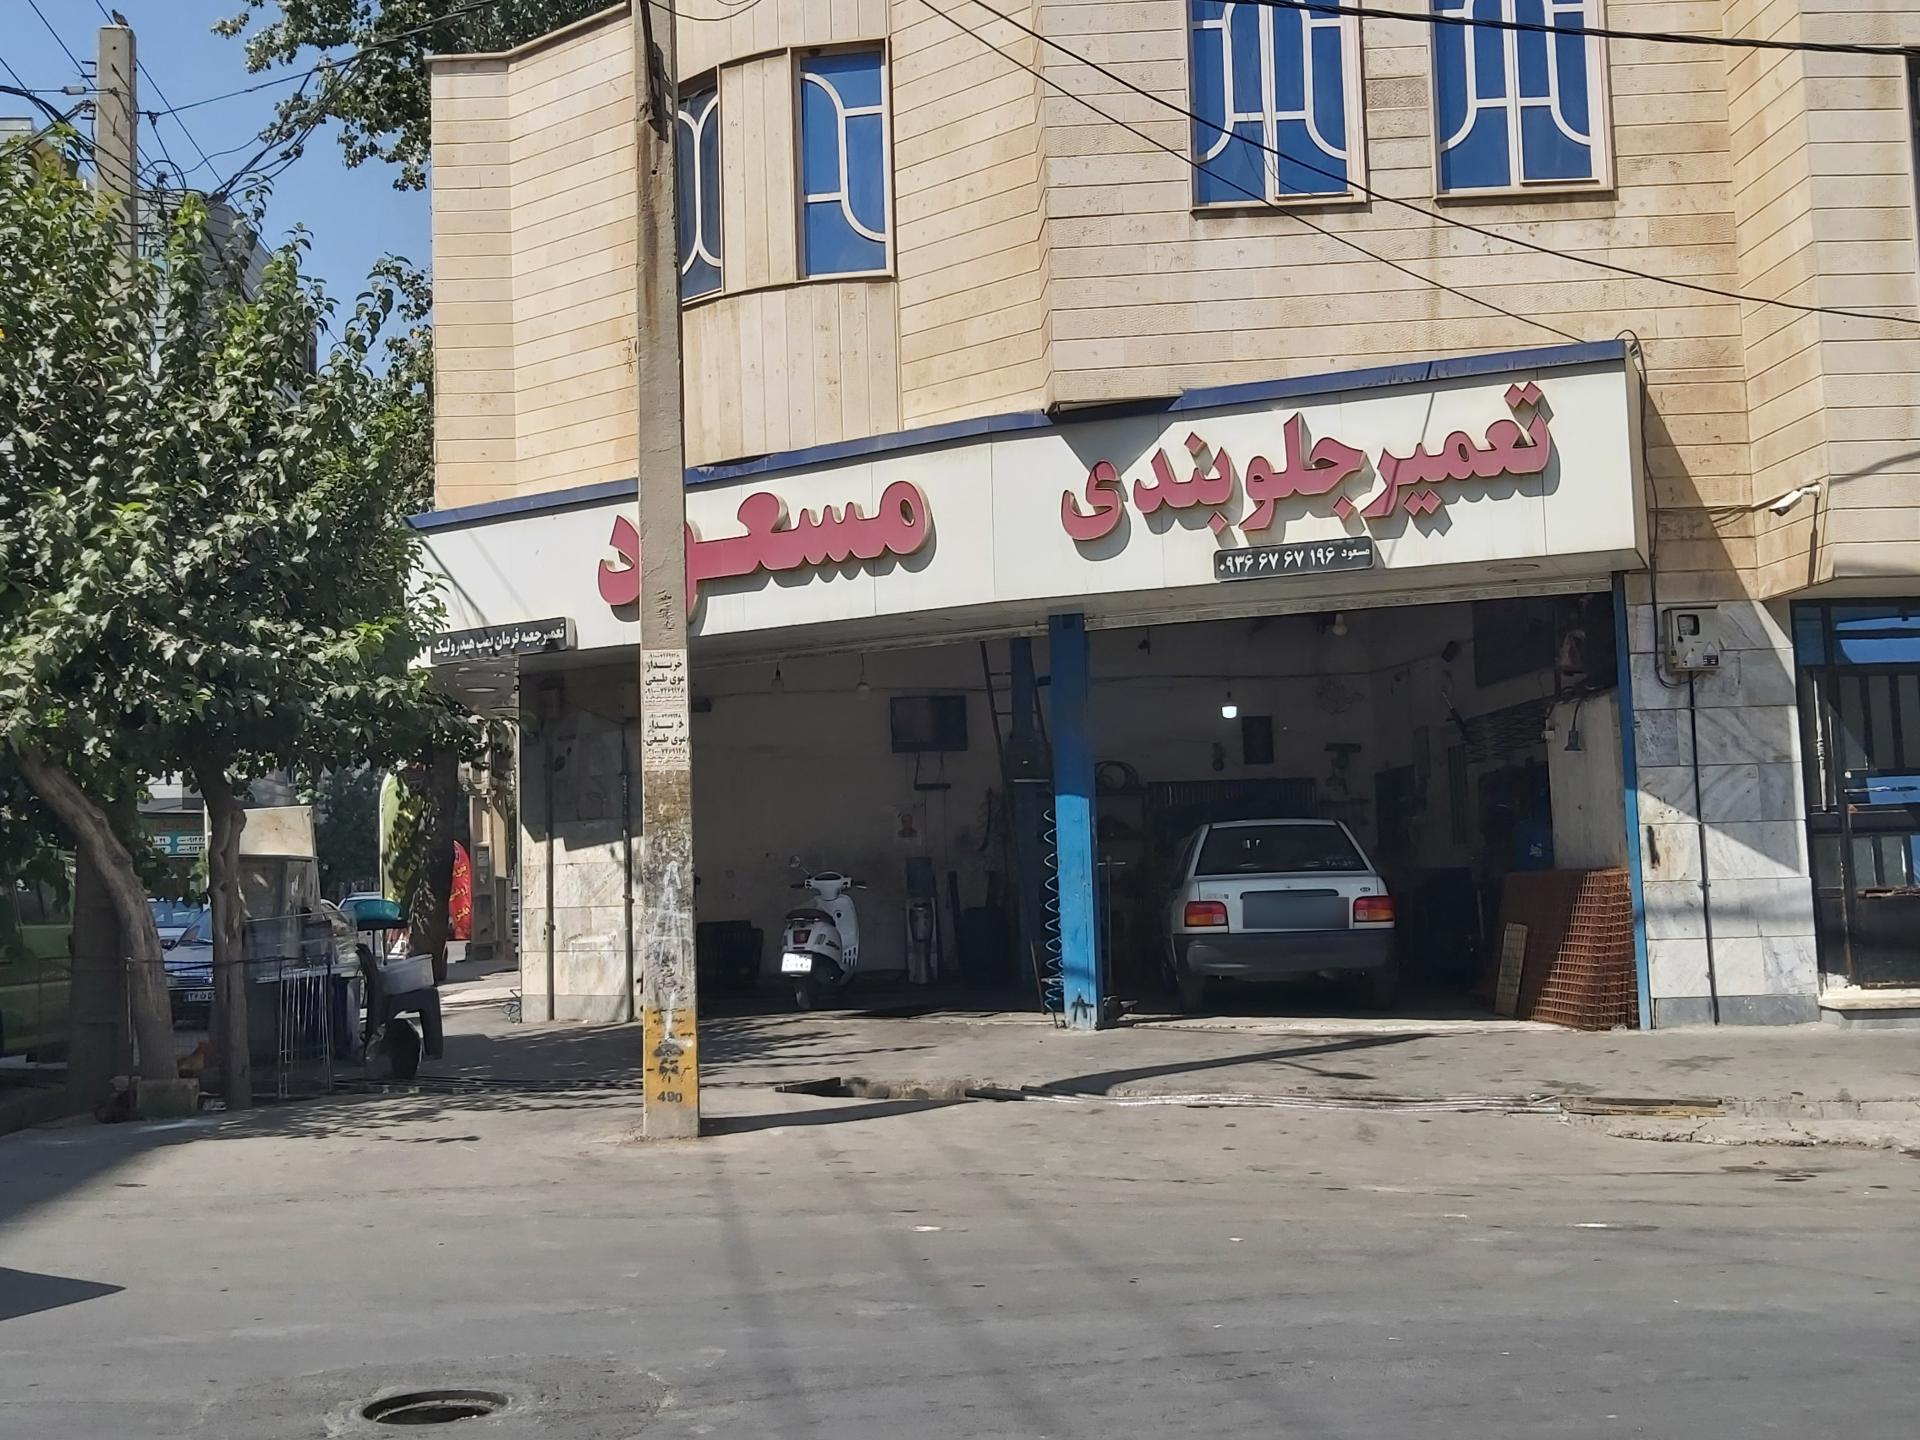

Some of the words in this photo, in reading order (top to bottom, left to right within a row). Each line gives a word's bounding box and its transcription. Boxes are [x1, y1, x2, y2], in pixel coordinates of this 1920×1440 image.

[1360, 381, 1551, 518] تعمیر
[1060, 411, 1364, 541] جلوبندی
[1219, 554, 1254, 574] ۰۹۳۶
[1258, 551, 1279, 571] ۶۷
[1283, 549, 1304, 568] ۶۷
[1310, 547, 1335, 567] ۱۹۶
[1341, 548, 1370, 560] مسعود
[476, 635, 494, 654] پمپ
[495, 628, 520, 651] فرمان
[521, 630, 542, 647] جعبه
[541, 623, 565, 646] تعمیر
[434, 638, 475, 657] هیدرولیک
[657, 1091, 683, 1103] 490
